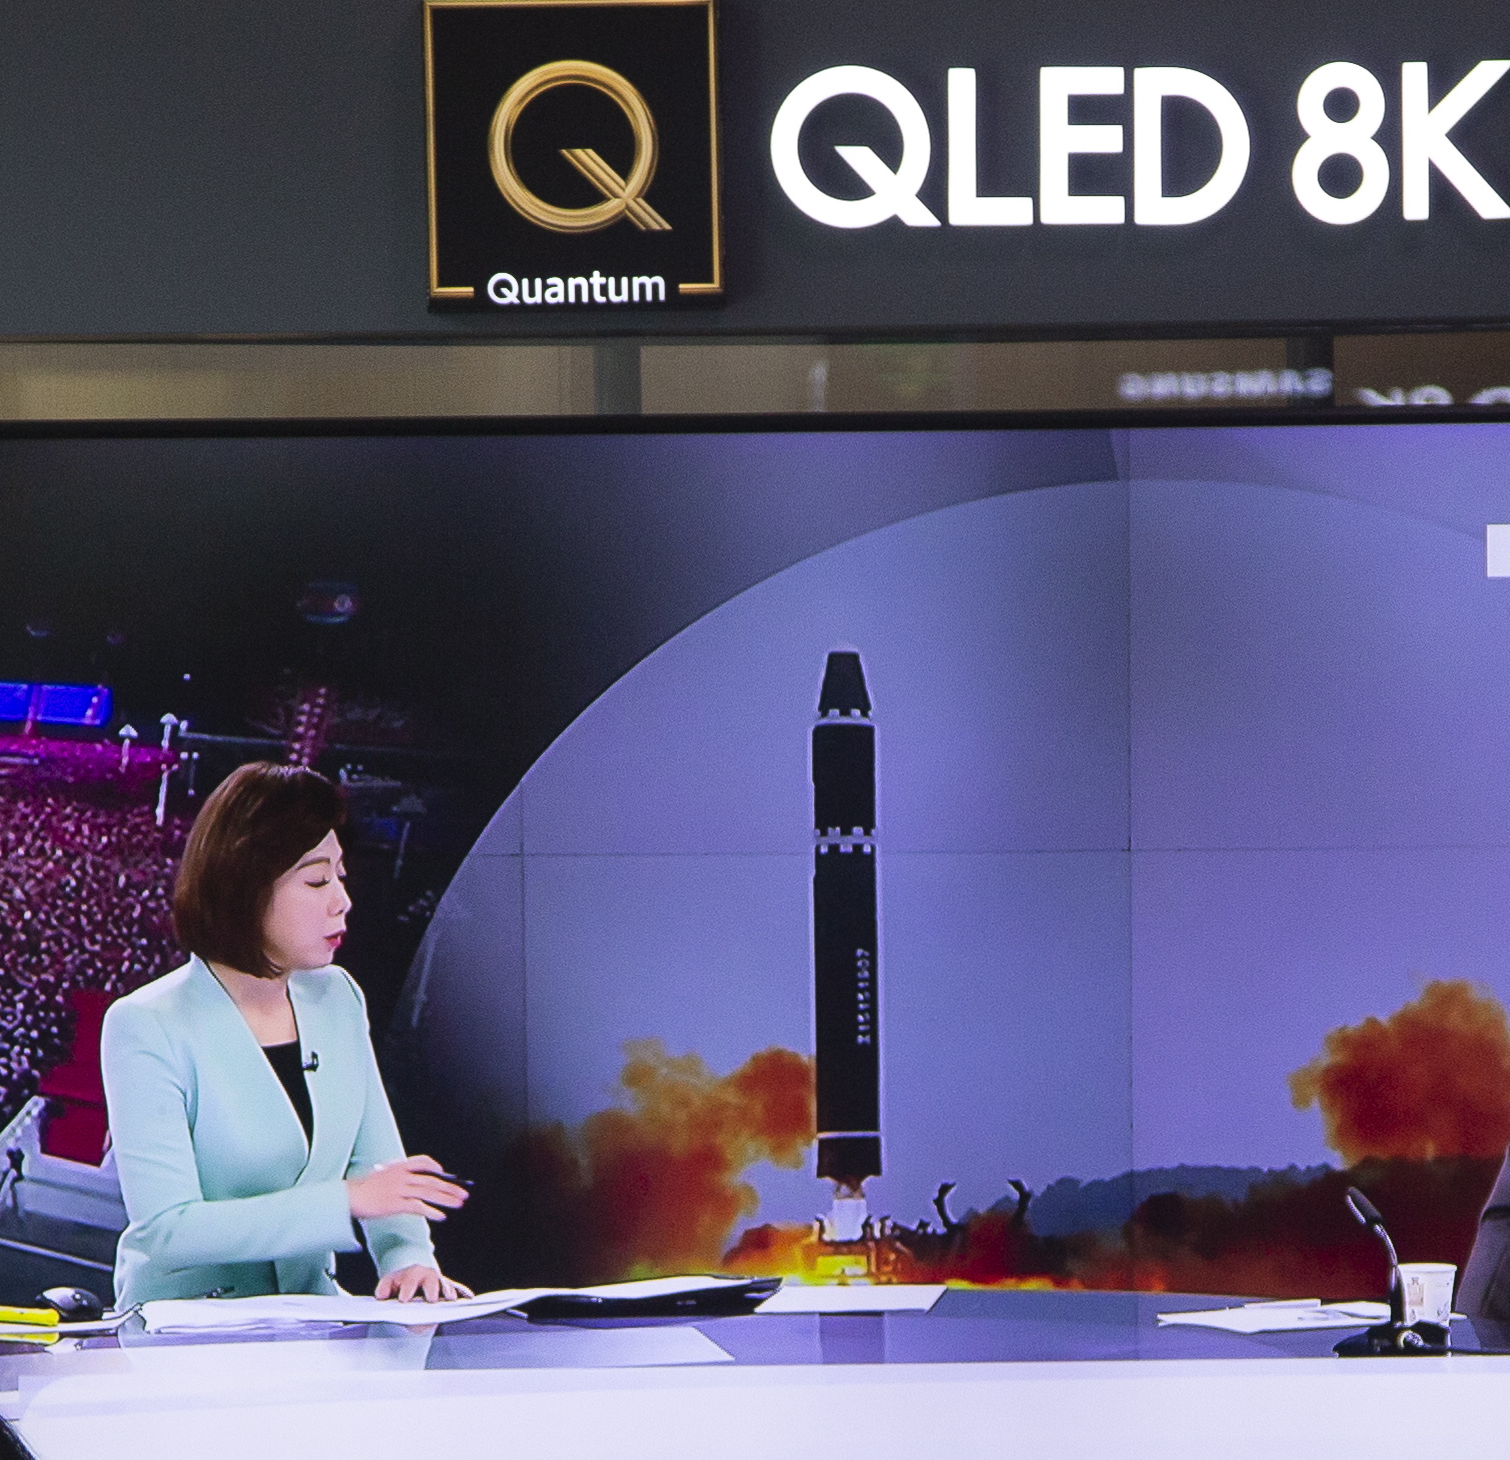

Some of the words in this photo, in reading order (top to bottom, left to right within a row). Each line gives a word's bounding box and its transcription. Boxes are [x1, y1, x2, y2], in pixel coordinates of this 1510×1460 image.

[487, 59, 673, 234] Q
[770, 64, 1251, 229] QLED
[487, 270, 666, 305] Quantum
